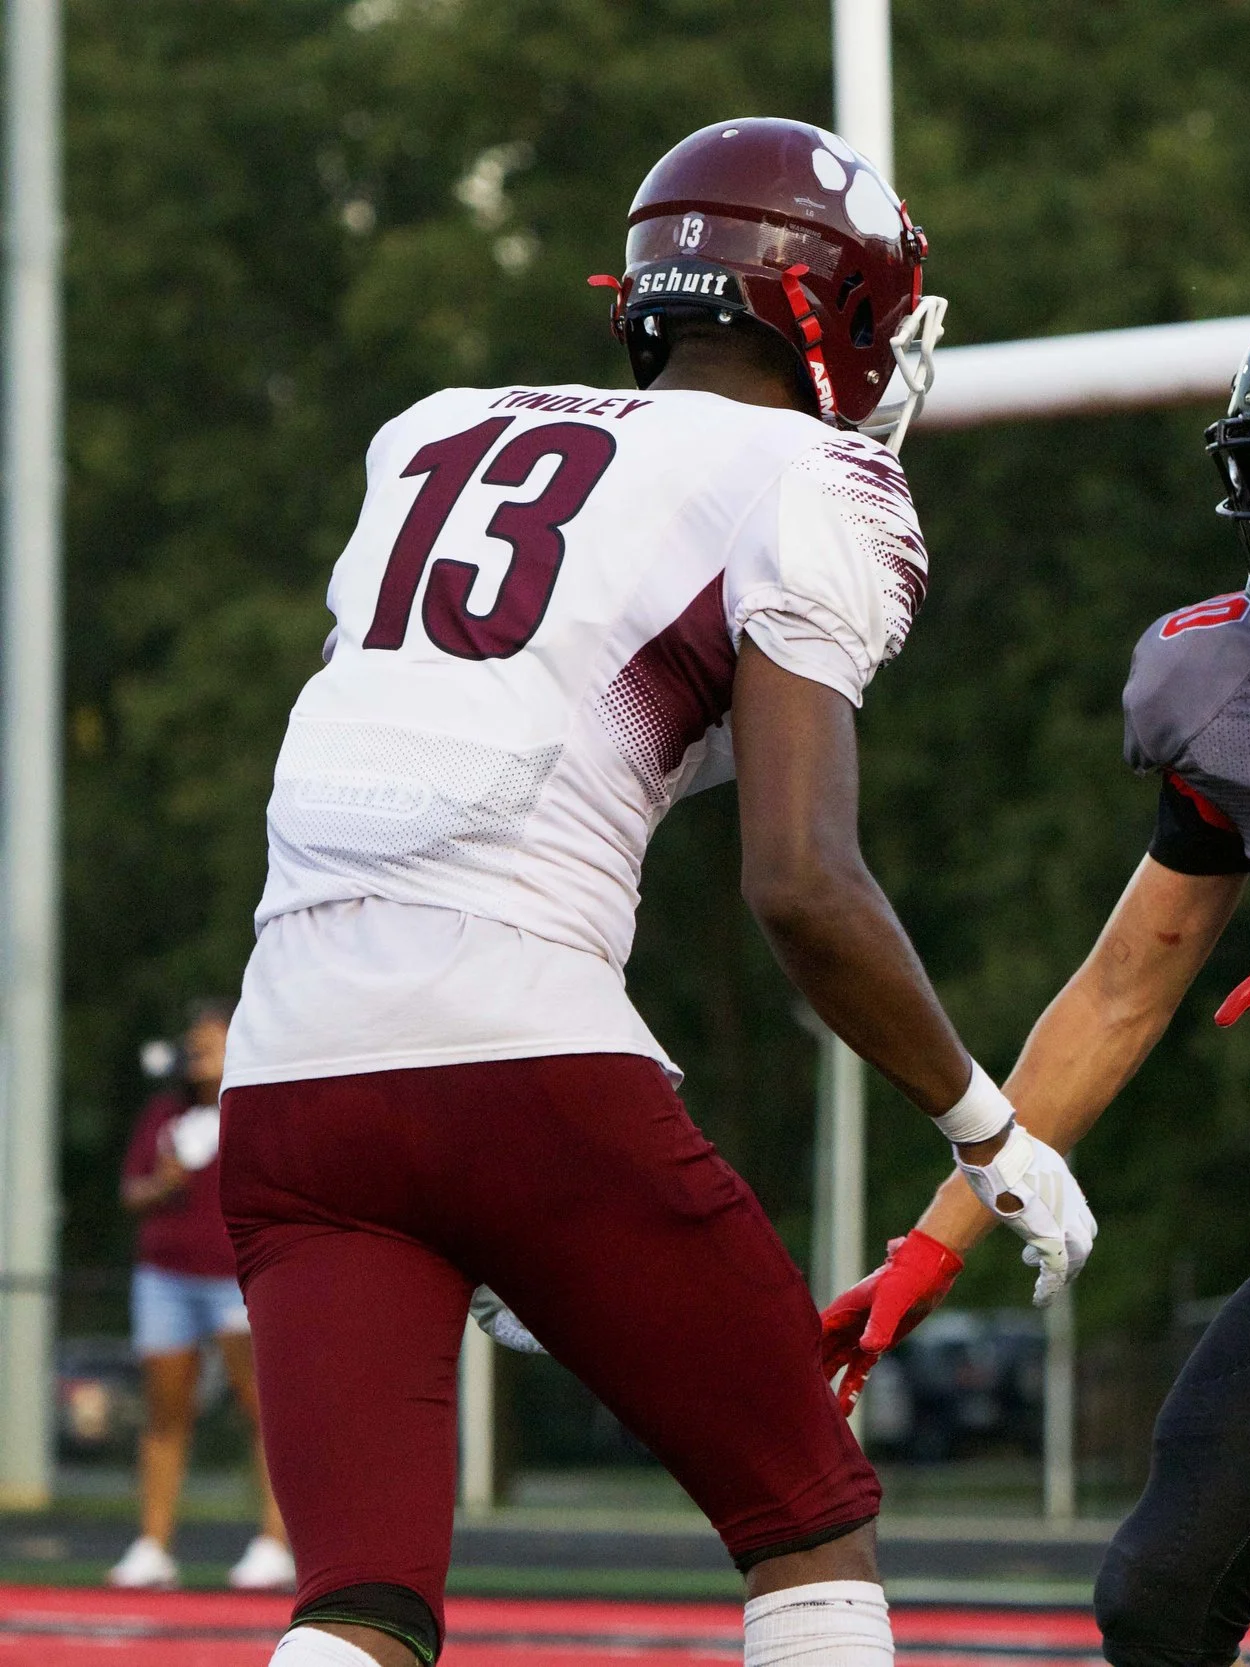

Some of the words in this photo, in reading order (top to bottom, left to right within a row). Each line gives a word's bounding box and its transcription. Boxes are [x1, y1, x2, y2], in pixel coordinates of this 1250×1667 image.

[679, 218, 704, 248] 13
[637, 267, 728, 296] schutt
[488, 390, 654, 419] TINDLEY
[362, 415, 617, 661] 13
